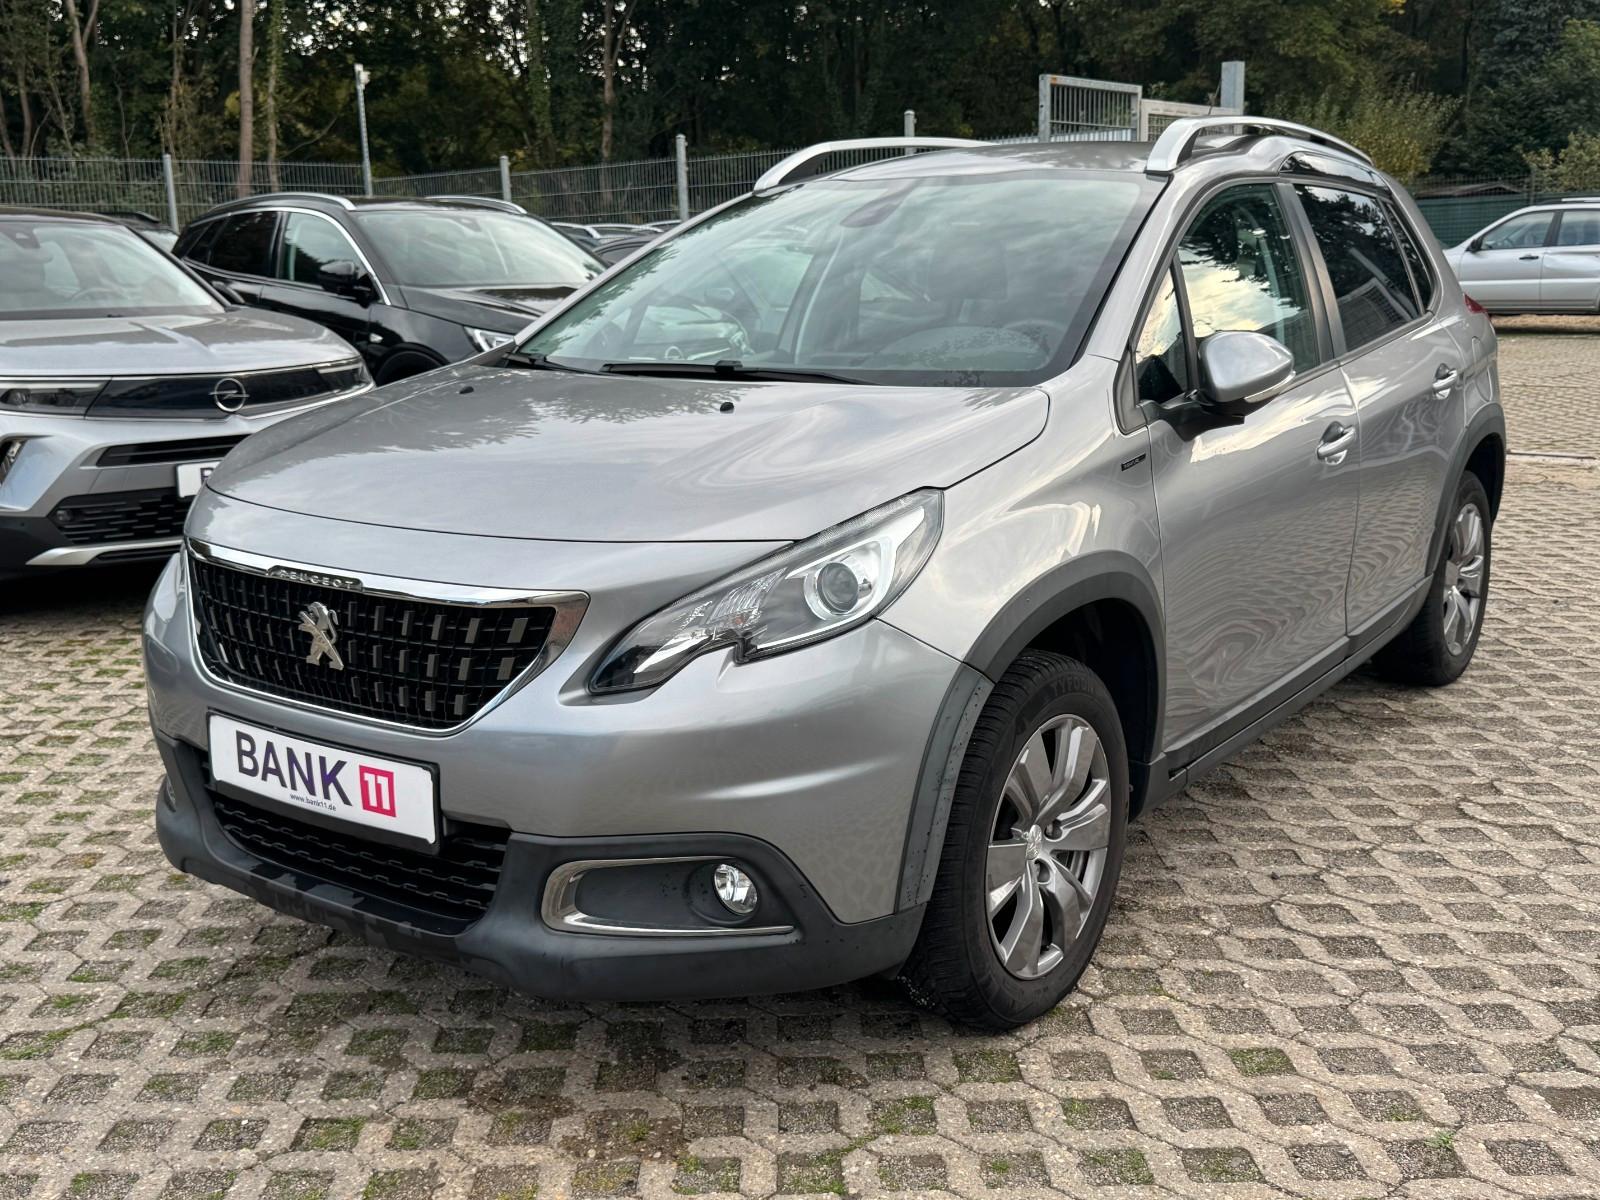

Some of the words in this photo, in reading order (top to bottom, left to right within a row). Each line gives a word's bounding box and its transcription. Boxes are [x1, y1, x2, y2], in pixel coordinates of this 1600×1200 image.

[280, 569, 353, 589] PEUGEOT
[236, 730, 352, 806] BANK
[363, 772, 391, 811] 11
[290, 793, 336, 811] www.bank11.de
